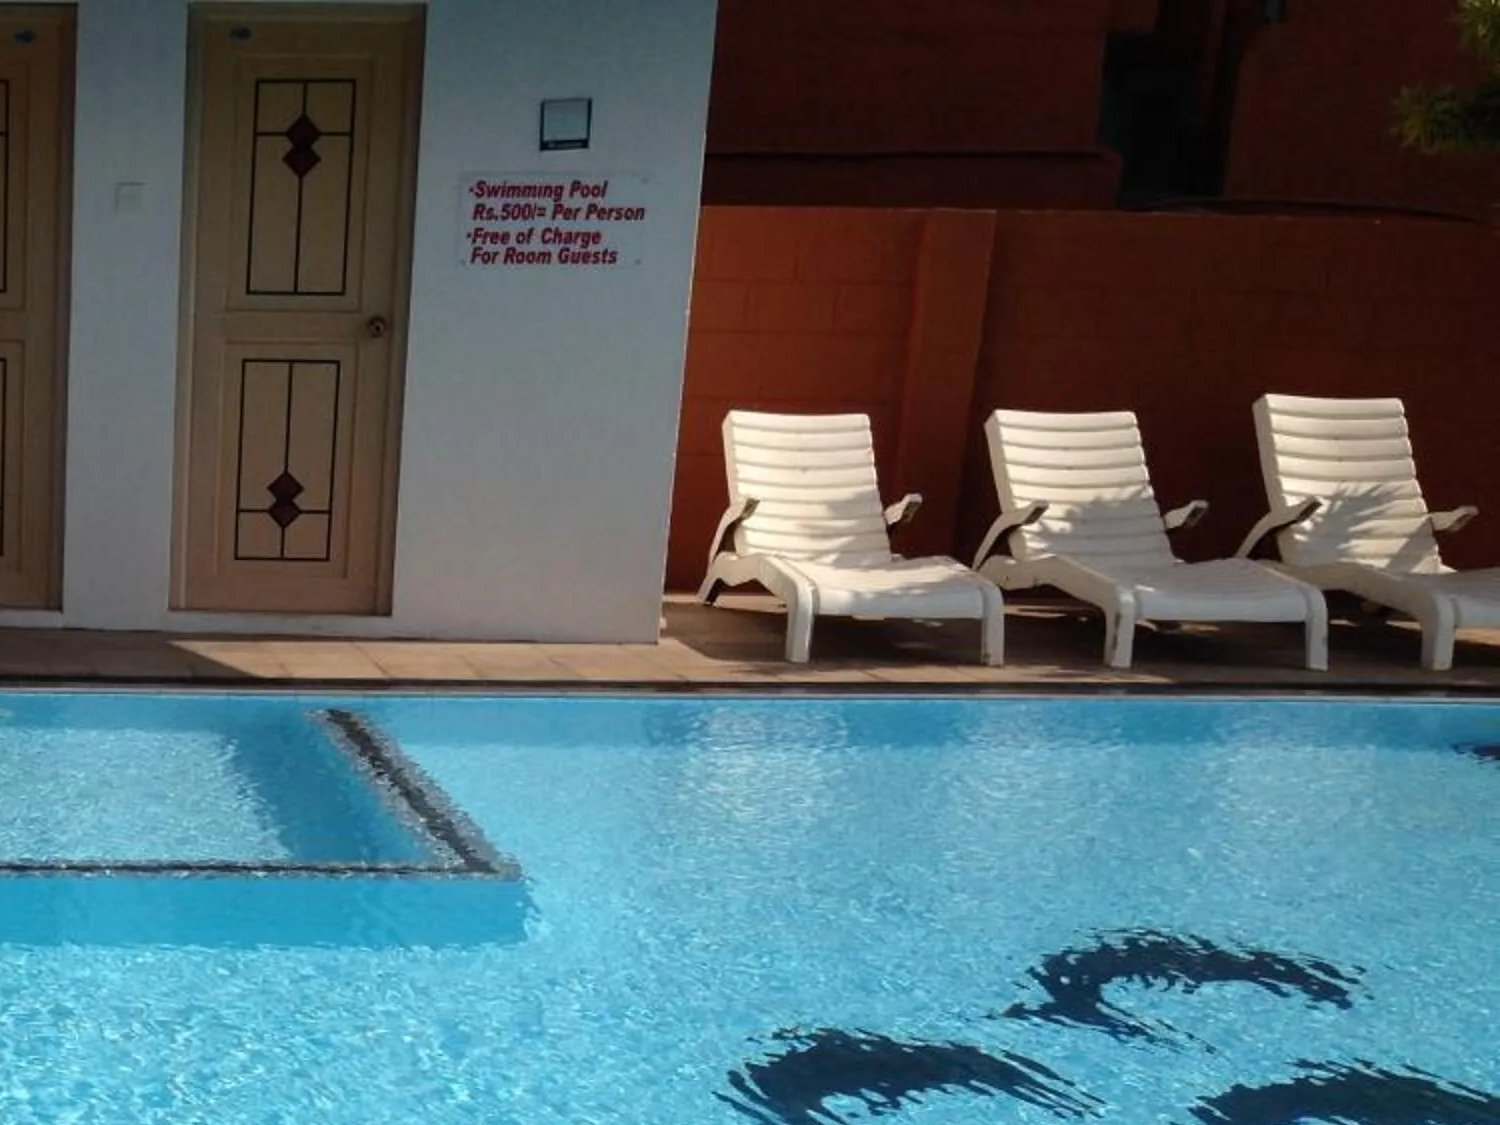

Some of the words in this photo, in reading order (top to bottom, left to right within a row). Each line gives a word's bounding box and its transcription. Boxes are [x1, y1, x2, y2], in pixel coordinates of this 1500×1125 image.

[474, 180, 565, 201] Swimming
[569, 180, 608, 198] Pool
[552, 203, 581, 221] Per
[585, 203, 645, 221] Person
[472, 227, 511, 245] Free
[515, 227, 534, 245] of
[541, 227, 602, 248] Charge
[470, 246, 500, 264] For
[503, 247, 552, 265] Room
[557, 247, 618, 265] Guests
